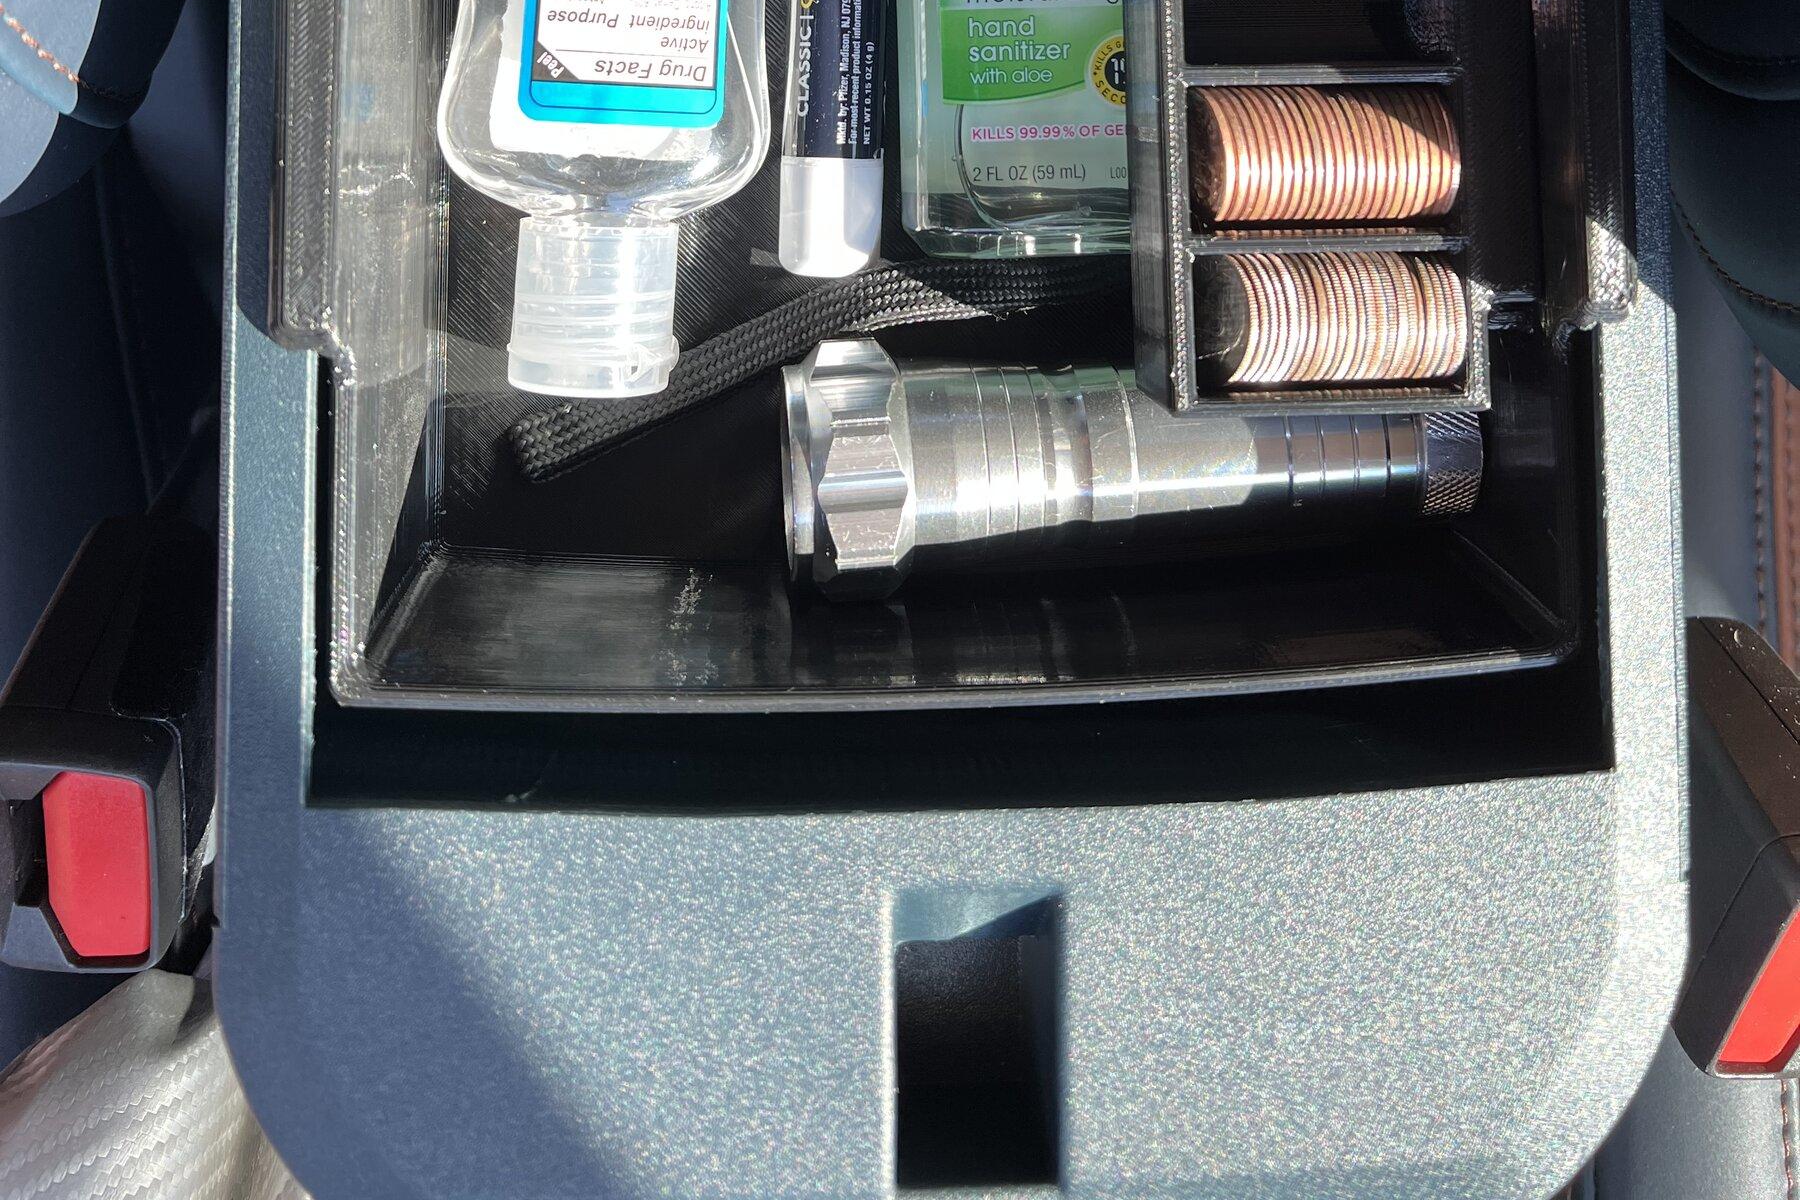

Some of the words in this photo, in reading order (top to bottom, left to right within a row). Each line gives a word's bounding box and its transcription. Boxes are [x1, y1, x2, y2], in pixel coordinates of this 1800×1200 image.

[548, 8, 619, 28] Purpose
[629, 15, 710, 34] ingredient
[841, 17, 851, 28] NJ
[968, 15, 1035, 38] hand
[661, 37, 709, 53] Active
[840, 31, 851, 71] Madison,
[865, 41, 875, 52] g)
[968, 40, 1071, 62] sanitizer
[537, 51, 565, 79] Peel
[852, 41, 862, 73] product
[865, 54, 874, 64] (4
[594, 60, 652, 79] Facts
[659, 60, 707, 82] Drug
[797, 26, 811, 117] CLASSIC
[865, 66, 873, 80] OZ
[970, 68, 1007, 85] with
[1011, 67, 1053, 83] aloe
[838, 74, 849, 101] Pfizer,
[851, 75, 860, 103] recent
[864, 82, 872, 104] 0.15
[838, 103, 849, 117] by:
[849, 105, 859, 128] most
[864, 107, 871, 123] WT
[836, 119, 846, 144] Mktd.
[849, 129, 857, 144] For
[863, 126, 871, 144] NET
[971, 128, 1014, 140] KILLS
[1019, 126, 1075, 139] 99.99%
[1080, 125, 1100, 137] OF
[1104, 124, 1127, 136] GE
[973, 167, 982, 181] 2
[987, 167, 1003, 181] FL
[1008, 166, 1028, 180] OZ
[1033, 166, 1055, 183] (59
[1060, 164, 1086, 180] mL)
